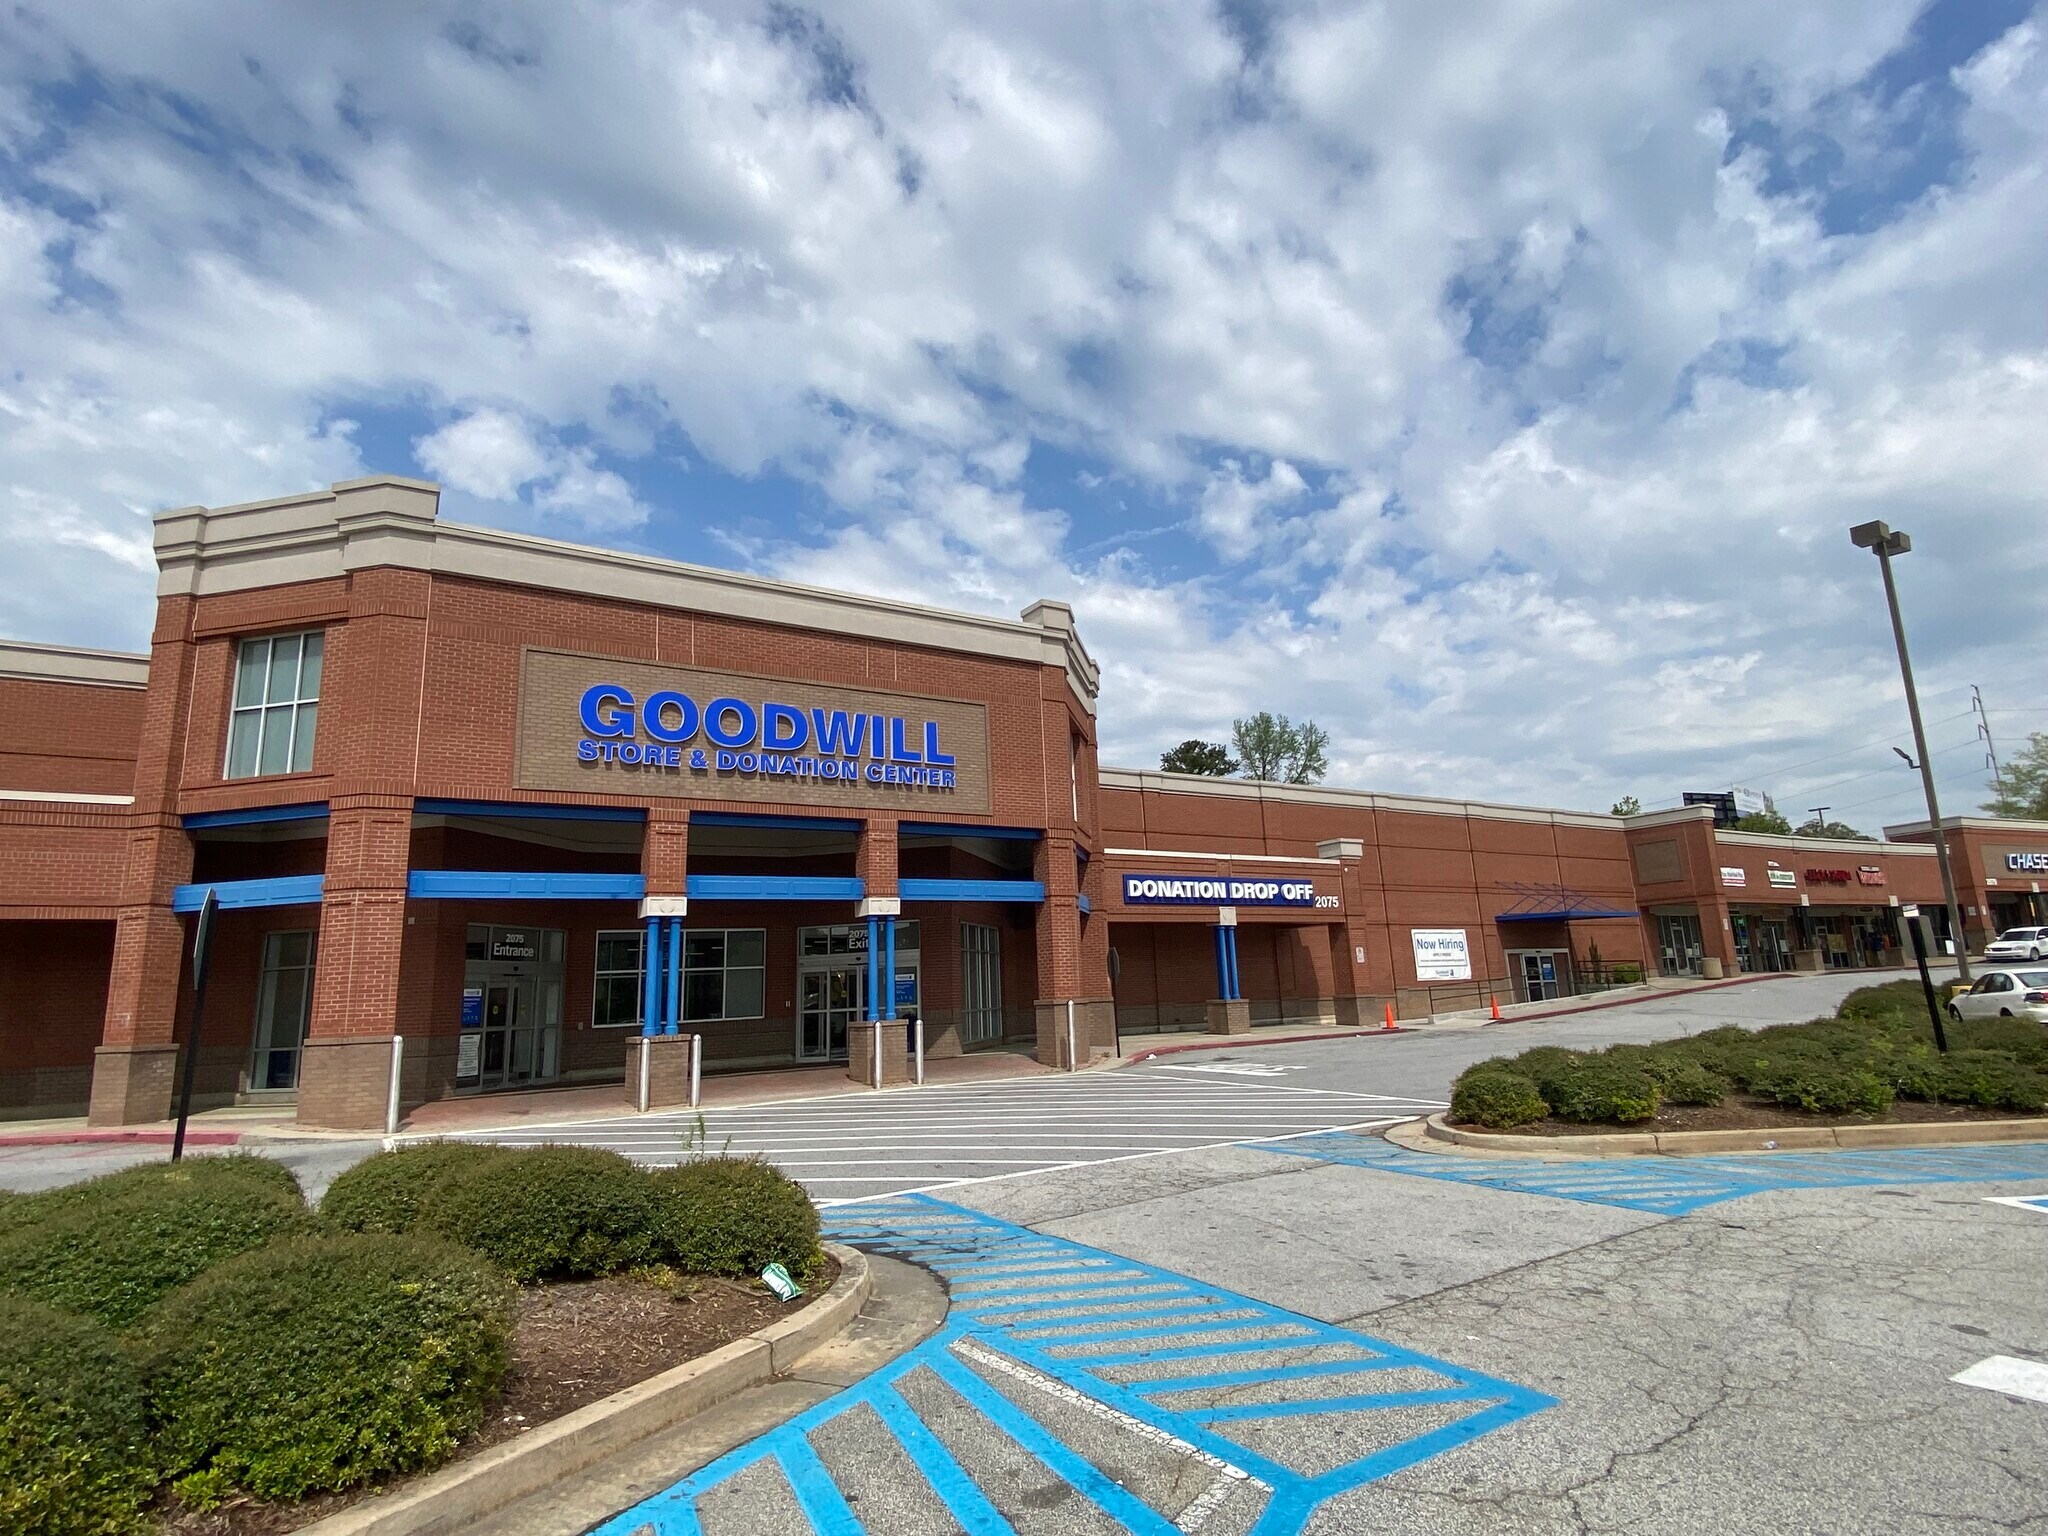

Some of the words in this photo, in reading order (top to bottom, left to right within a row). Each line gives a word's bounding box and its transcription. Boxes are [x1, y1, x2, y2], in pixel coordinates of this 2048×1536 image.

[579, 683, 956, 765] GOODWILL
[577, 739, 681, 768] STORE
[689, 749, 708, 770] &
[716, 750, 858, 780] DONATION
[865, 763, 956, 788] CENTER
[2007, 853, 2048, 869] CHASE
[1127, 879, 1226, 899] DONATION
[1230, 881, 1279, 900] DROP
[1282, 883, 1313, 900] OFF
[1315, 896, 1339, 908] 2075
[505, 933, 524, 943] 2075
[1416, 938, 1436, 950] Now
[1438, 938, 1464, 951] Hiring
[493, 942, 534, 957] Entrance
